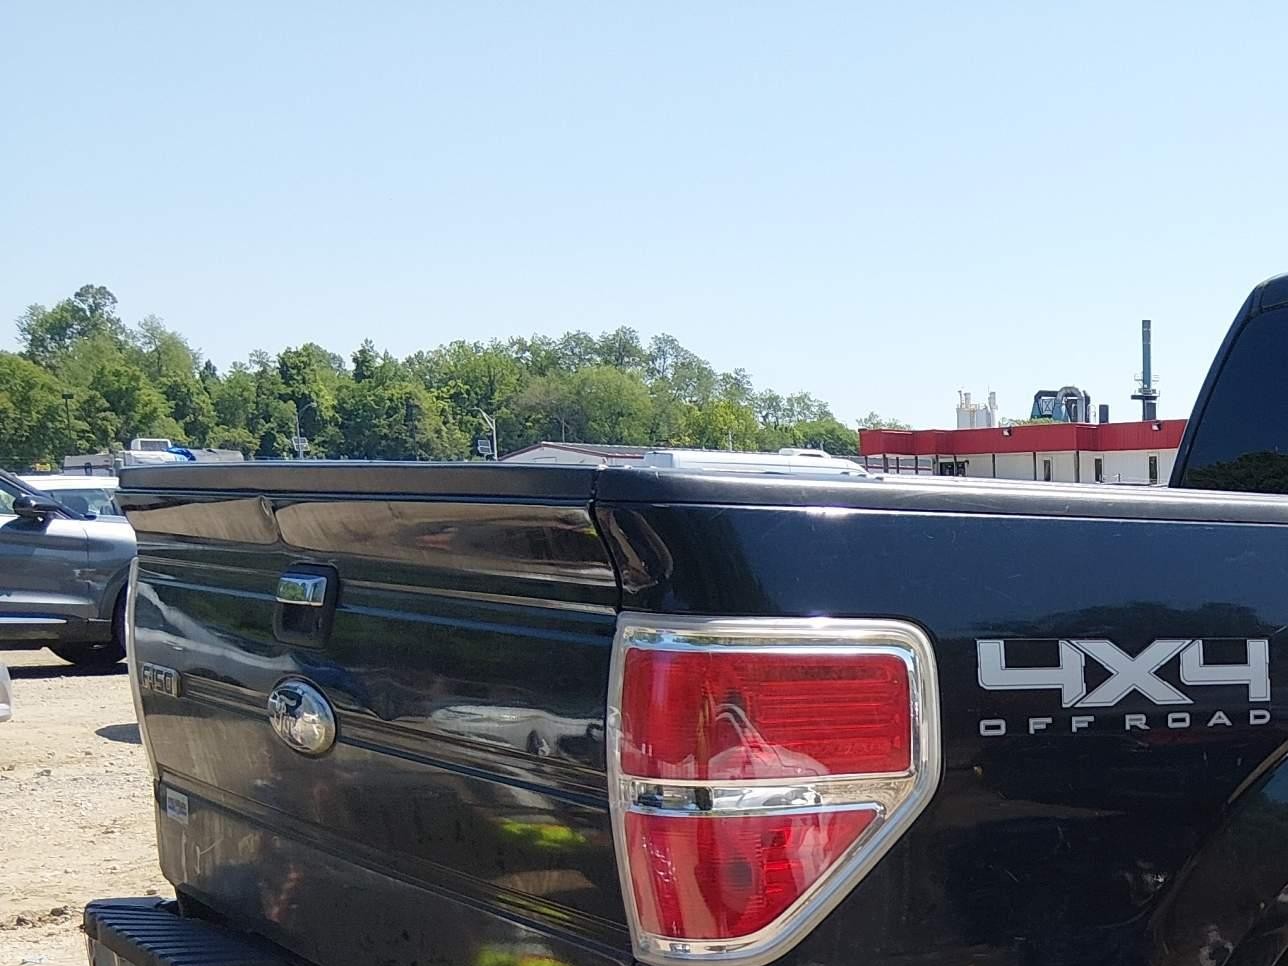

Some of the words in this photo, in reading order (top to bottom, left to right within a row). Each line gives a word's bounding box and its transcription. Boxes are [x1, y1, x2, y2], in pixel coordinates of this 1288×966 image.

[976, 638, 1271, 708] 4X4
[979, 714, 1095, 736] OFF
[1124, 709, 1271, 730] ROAD
